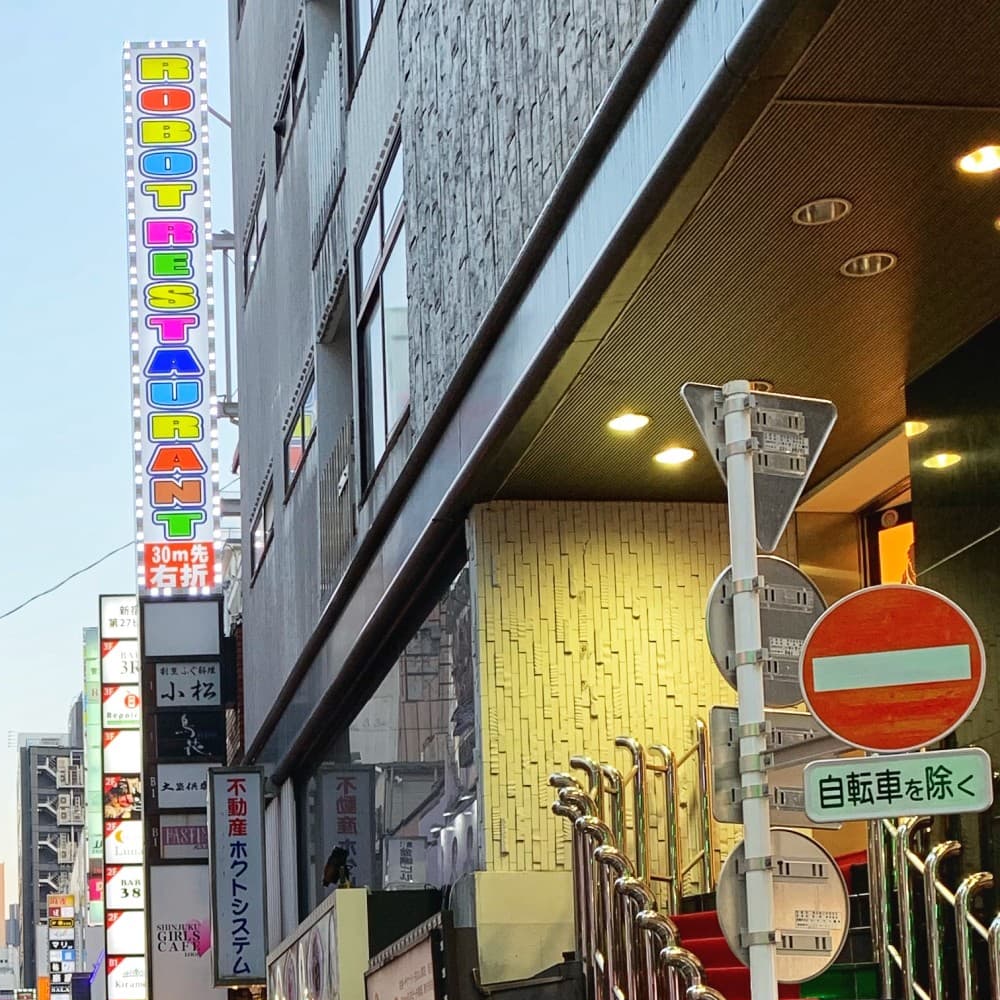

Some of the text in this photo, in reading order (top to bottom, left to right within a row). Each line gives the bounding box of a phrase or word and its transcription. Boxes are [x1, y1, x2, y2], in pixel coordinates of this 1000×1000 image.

[137, 54, 208, 541] ROBOT RESTAURANT
[151, 544, 209, 563] 30m先
[150, 563, 209, 588] 右折
[161, 680, 217, 701] 小松
[818, 766, 975, 809] 自転車を除く
[227, 778, 251, 974] 不動産ホクトシステム
[121, 888, 142, 899] 38
[157, 931, 201, 941] GIRLS
